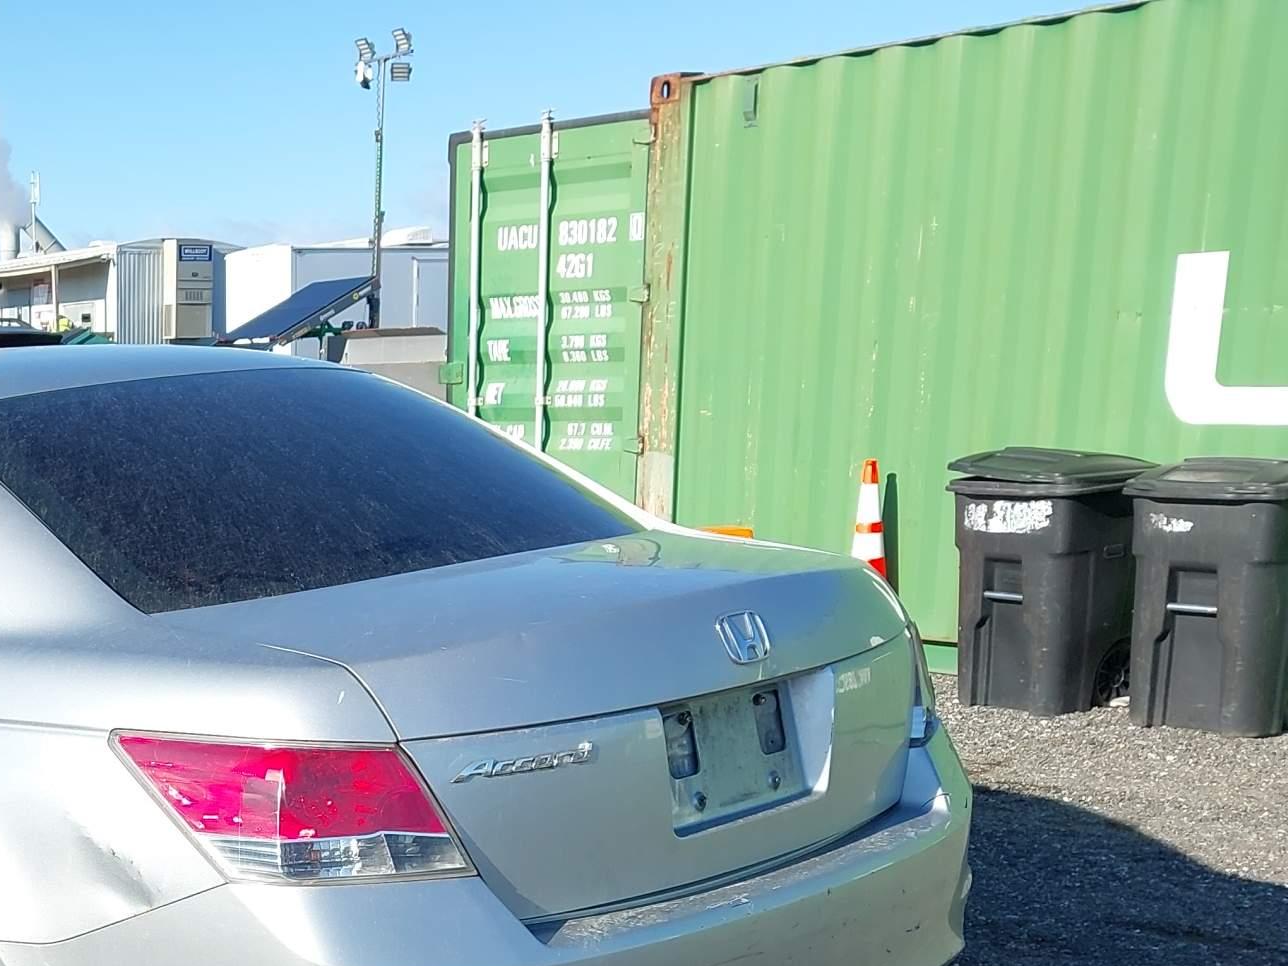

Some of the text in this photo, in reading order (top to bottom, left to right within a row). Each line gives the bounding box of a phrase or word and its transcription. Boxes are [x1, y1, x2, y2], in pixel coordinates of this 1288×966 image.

[497, 223, 538, 251] UACU
[559, 217, 617, 246] 830182
[556, 253, 593, 278] 42G1
[450, 741, 593, 783] Accord
